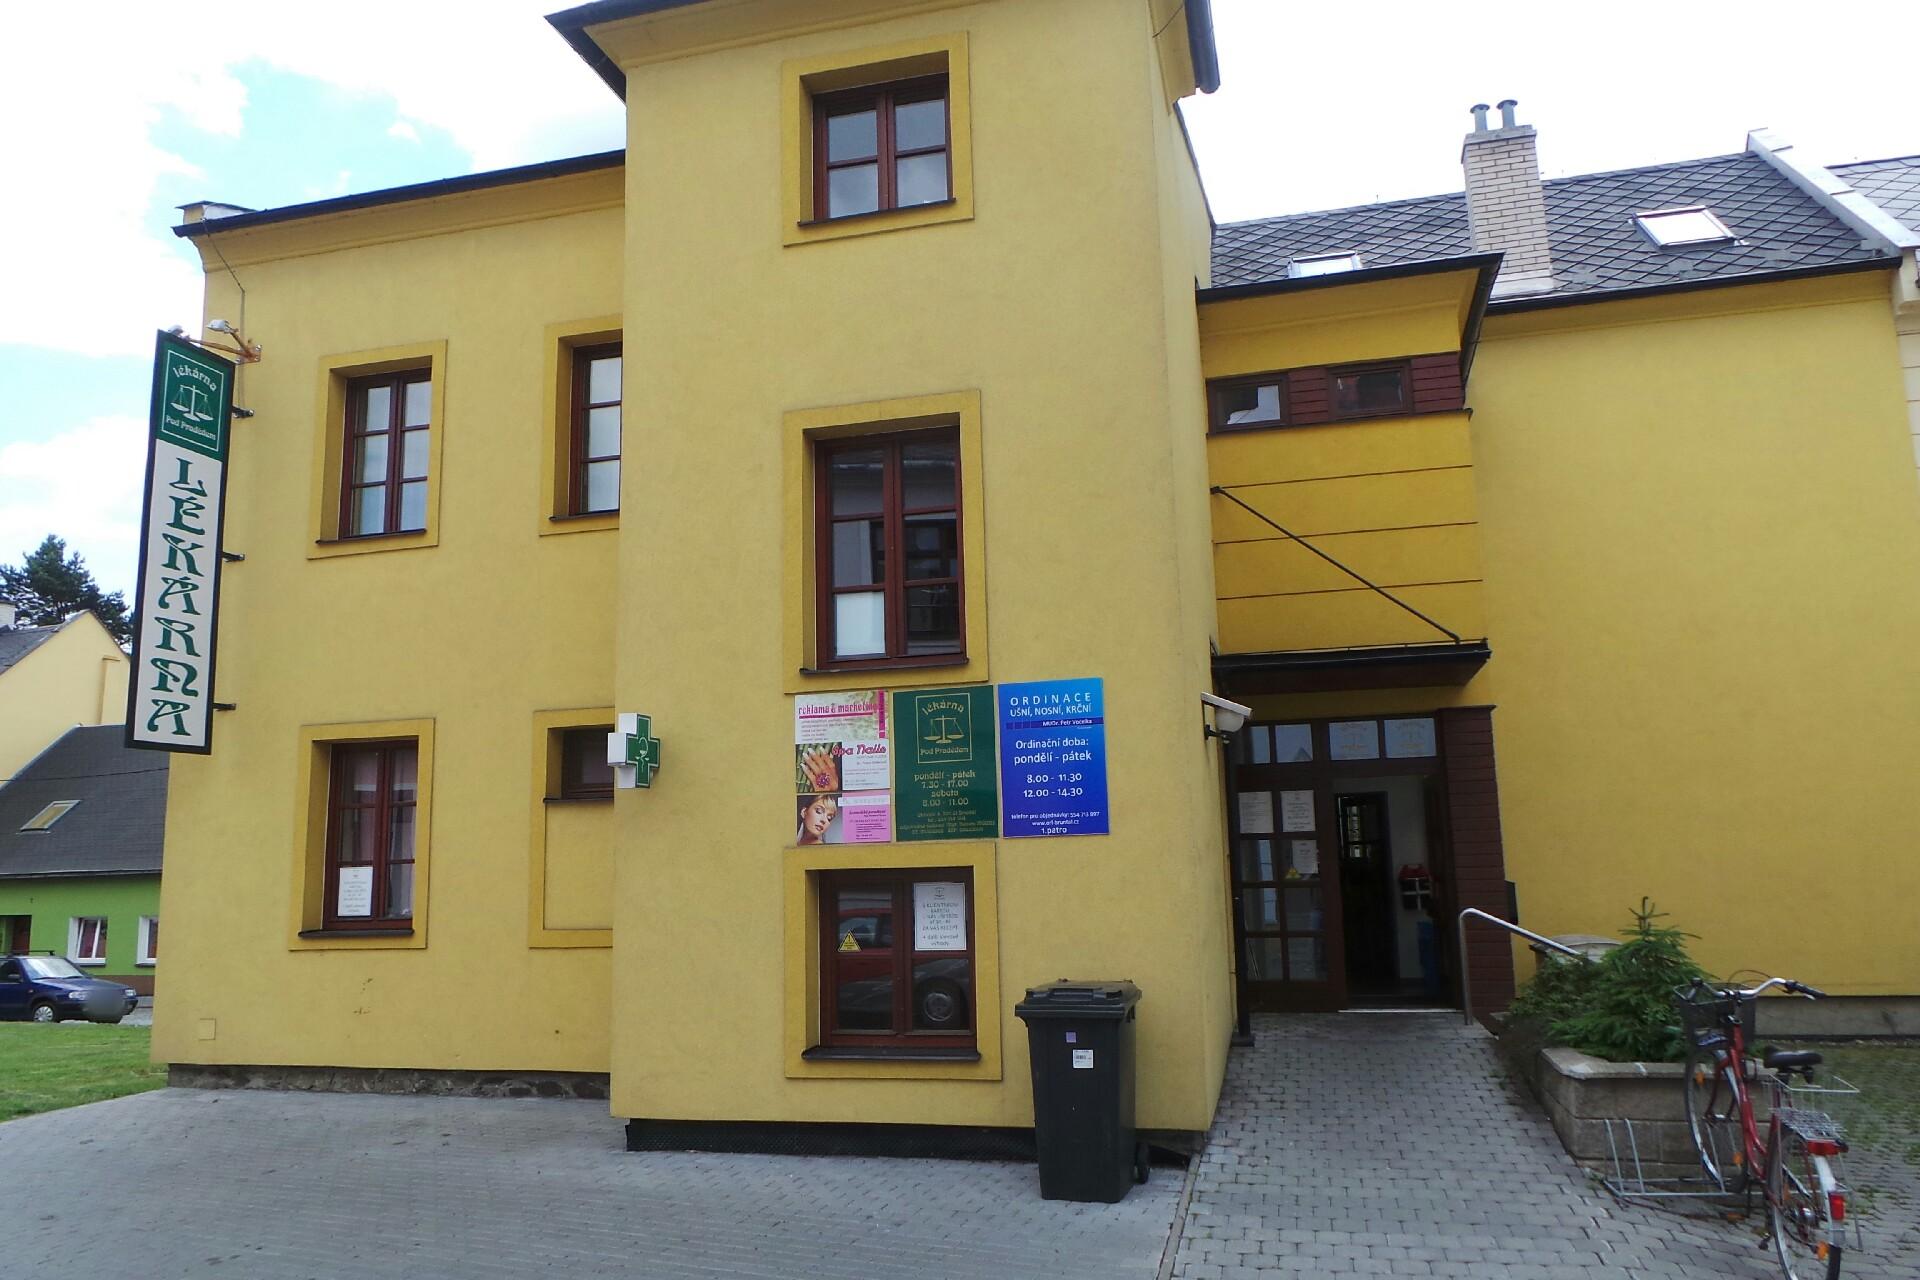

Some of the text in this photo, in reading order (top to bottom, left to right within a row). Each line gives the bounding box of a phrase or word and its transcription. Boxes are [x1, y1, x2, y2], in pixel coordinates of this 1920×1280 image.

[173, 364, 217, 392] lékárna
[165, 414, 180, 427] Pod
[146, 457, 207, 736] LÉKÁRNA
[1010, 692, 1091, 706] ORDINACE
[798, 703, 829, 715] reklama
[838, 700, 879, 714] marketing
[921, 699, 964, 715] lékárna
[1010, 702, 1092, 717] UŠNÍ, NOSNÍ, KRČNÍ
[1015, 736, 1089, 749] Ordinační doba:
[832, 744, 854, 757] Spa
[920, 748, 934, 756] Pod
[1014, 751, 1053, 766] pondělí
[1062, 749, 1092, 763] pátek
[914, 771, 944, 782] pondělí
[952, 769, 976, 780] pátek
[1026, 774, 1049, 784] 8.00
[1058, 773, 1082, 783] 11.30
[947, 779, 969, 788] 17.00
[931, 789, 959, 797] sobota
[1023, 789, 1049, 798] 12.00
[1057, 787, 1083, 797] 14.30
[949, 797, 969, 806] 11.00
